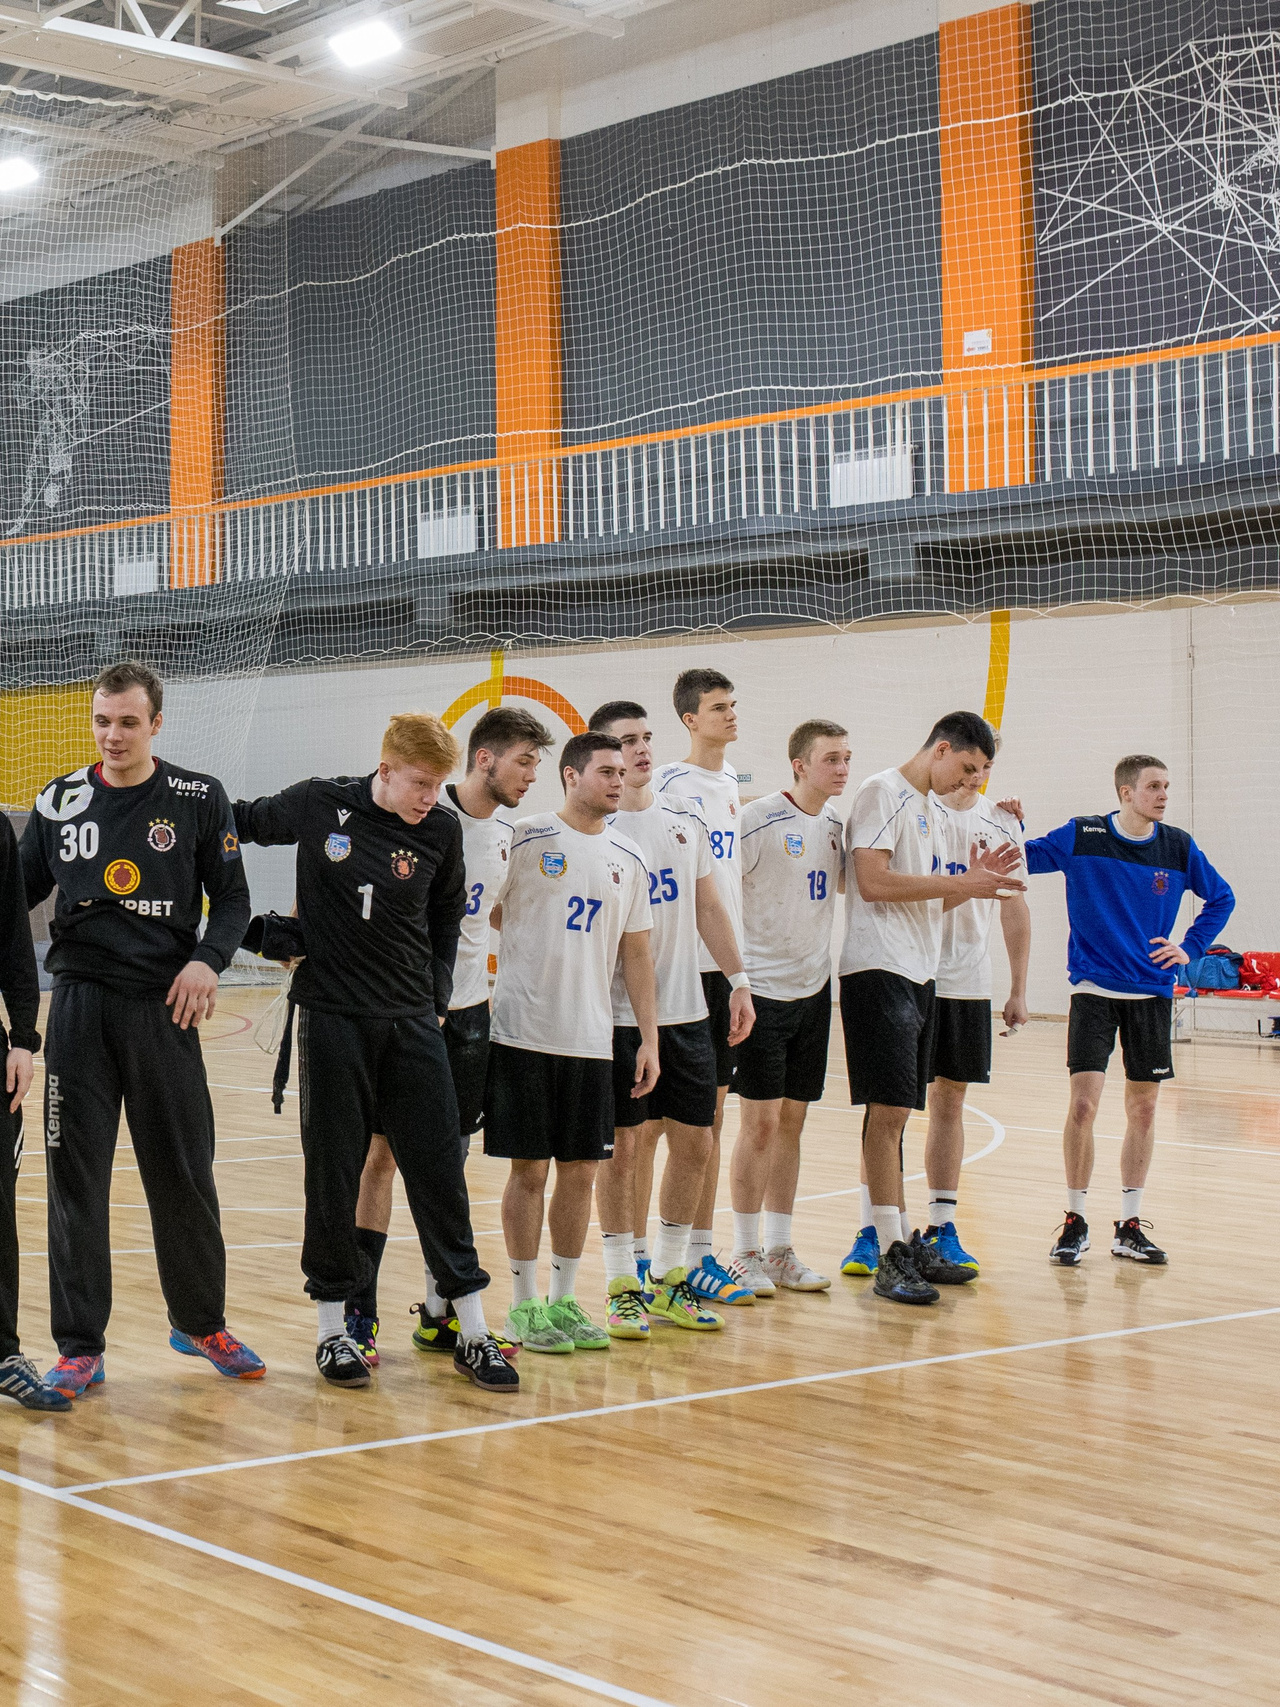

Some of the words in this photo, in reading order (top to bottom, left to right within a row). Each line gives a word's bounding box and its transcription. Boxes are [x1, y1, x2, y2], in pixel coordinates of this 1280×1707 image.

[167, 775, 210, 793] VinEx
[176, 791, 207, 800] media
[59, 821, 99, 862] 30
[525, 826, 554, 836] uhlsport
[710, 830, 735, 859] 87
[1082, 825, 1107, 834] Kempa
[648, 867, 679, 905] 25
[806, 870, 827, 901] 19
[357, 883, 374, 920] 1
[566, 895, 603, 933] 27
[46, 1073, 65, 1148] Kempa
